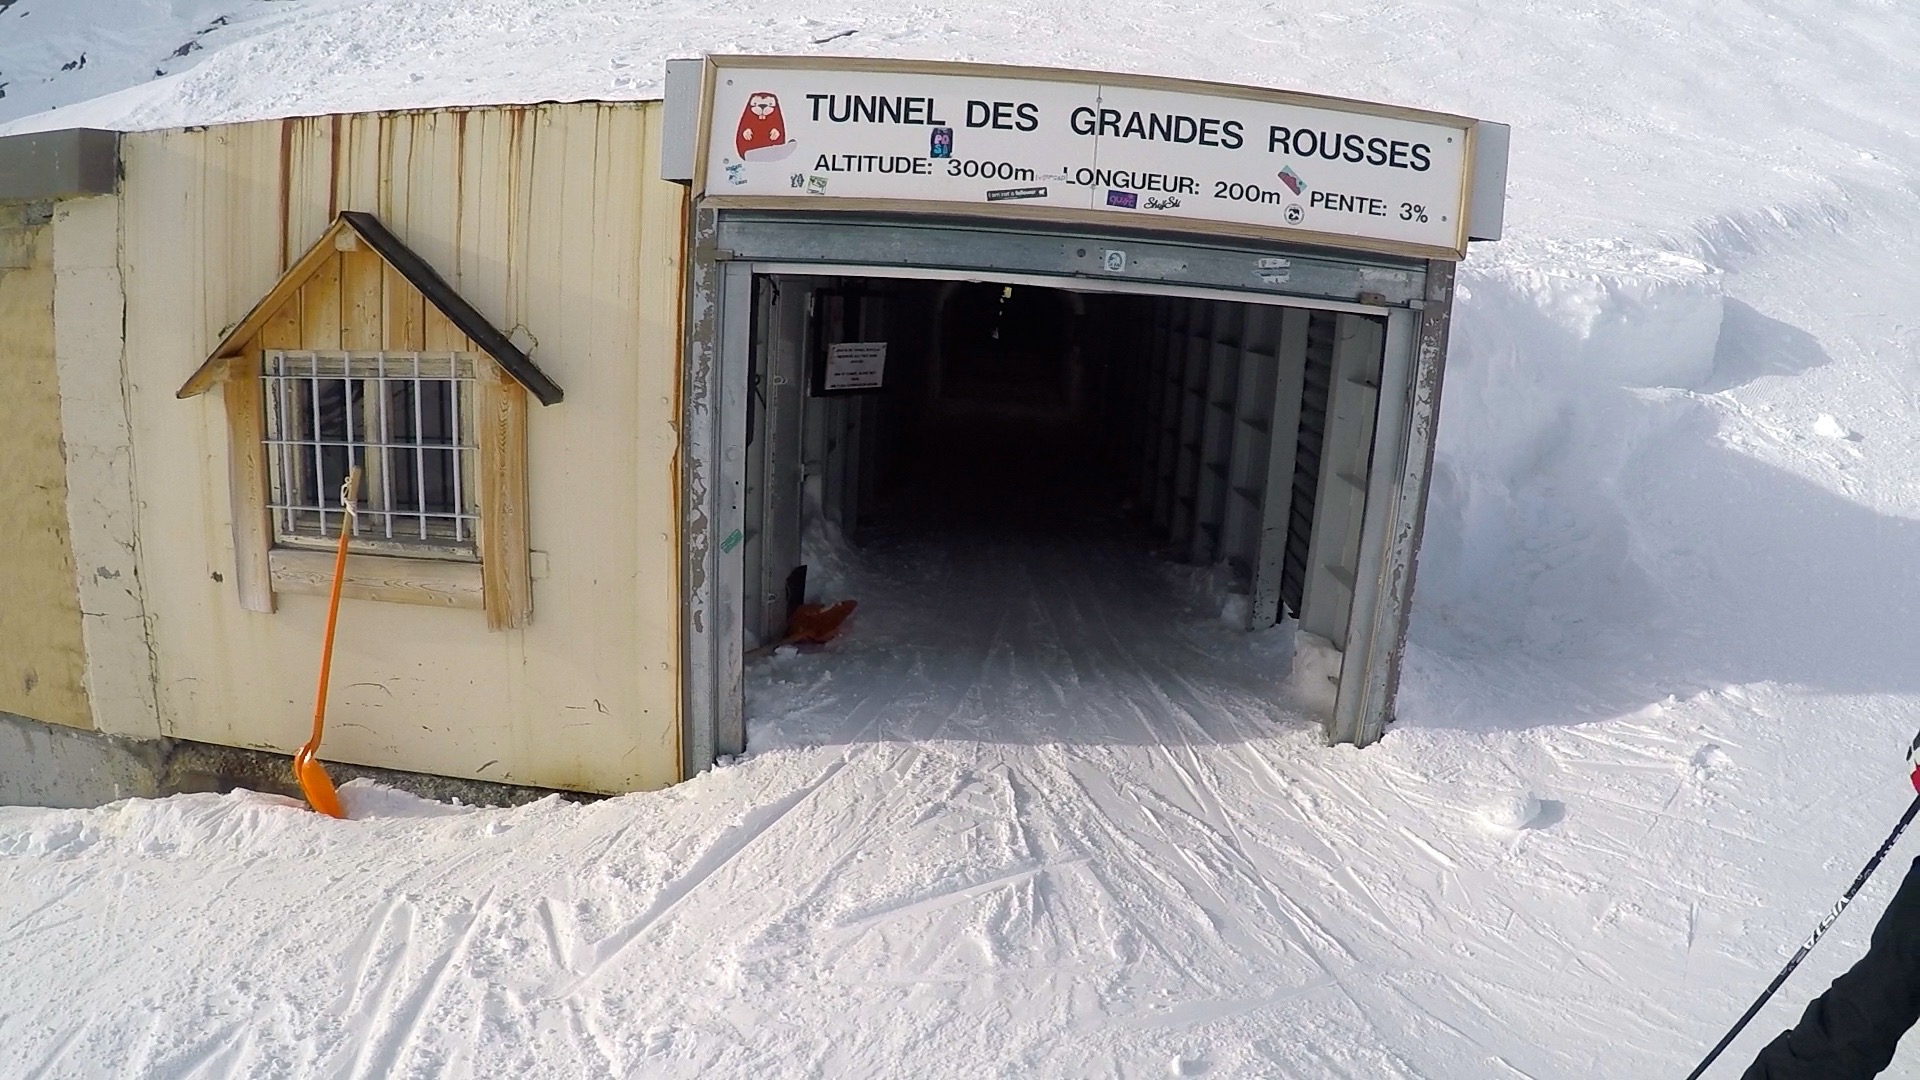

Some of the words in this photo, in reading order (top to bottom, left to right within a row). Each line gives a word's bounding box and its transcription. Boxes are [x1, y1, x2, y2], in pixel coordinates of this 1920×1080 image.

[805, 93, 946, 126] TUNNEL
[966, 100, 1039, 132] DES
[1070, 106, 1244, 150] GRANDES
[1268, 125, 1431, 172] ROUSSES
[813, 154, 933, 175] ALTITUDE:
[946, 158, 1035, 182] 3000m
[1063, 166, 1199, 195] LONGUEUR:
[1213, 181, 1281, 205] 200m
[1310, 190, 1387, 216] PENTE:
[1399, 202, 1429, 224] 3%
[1803, 896, 1850, 949] VISTA
